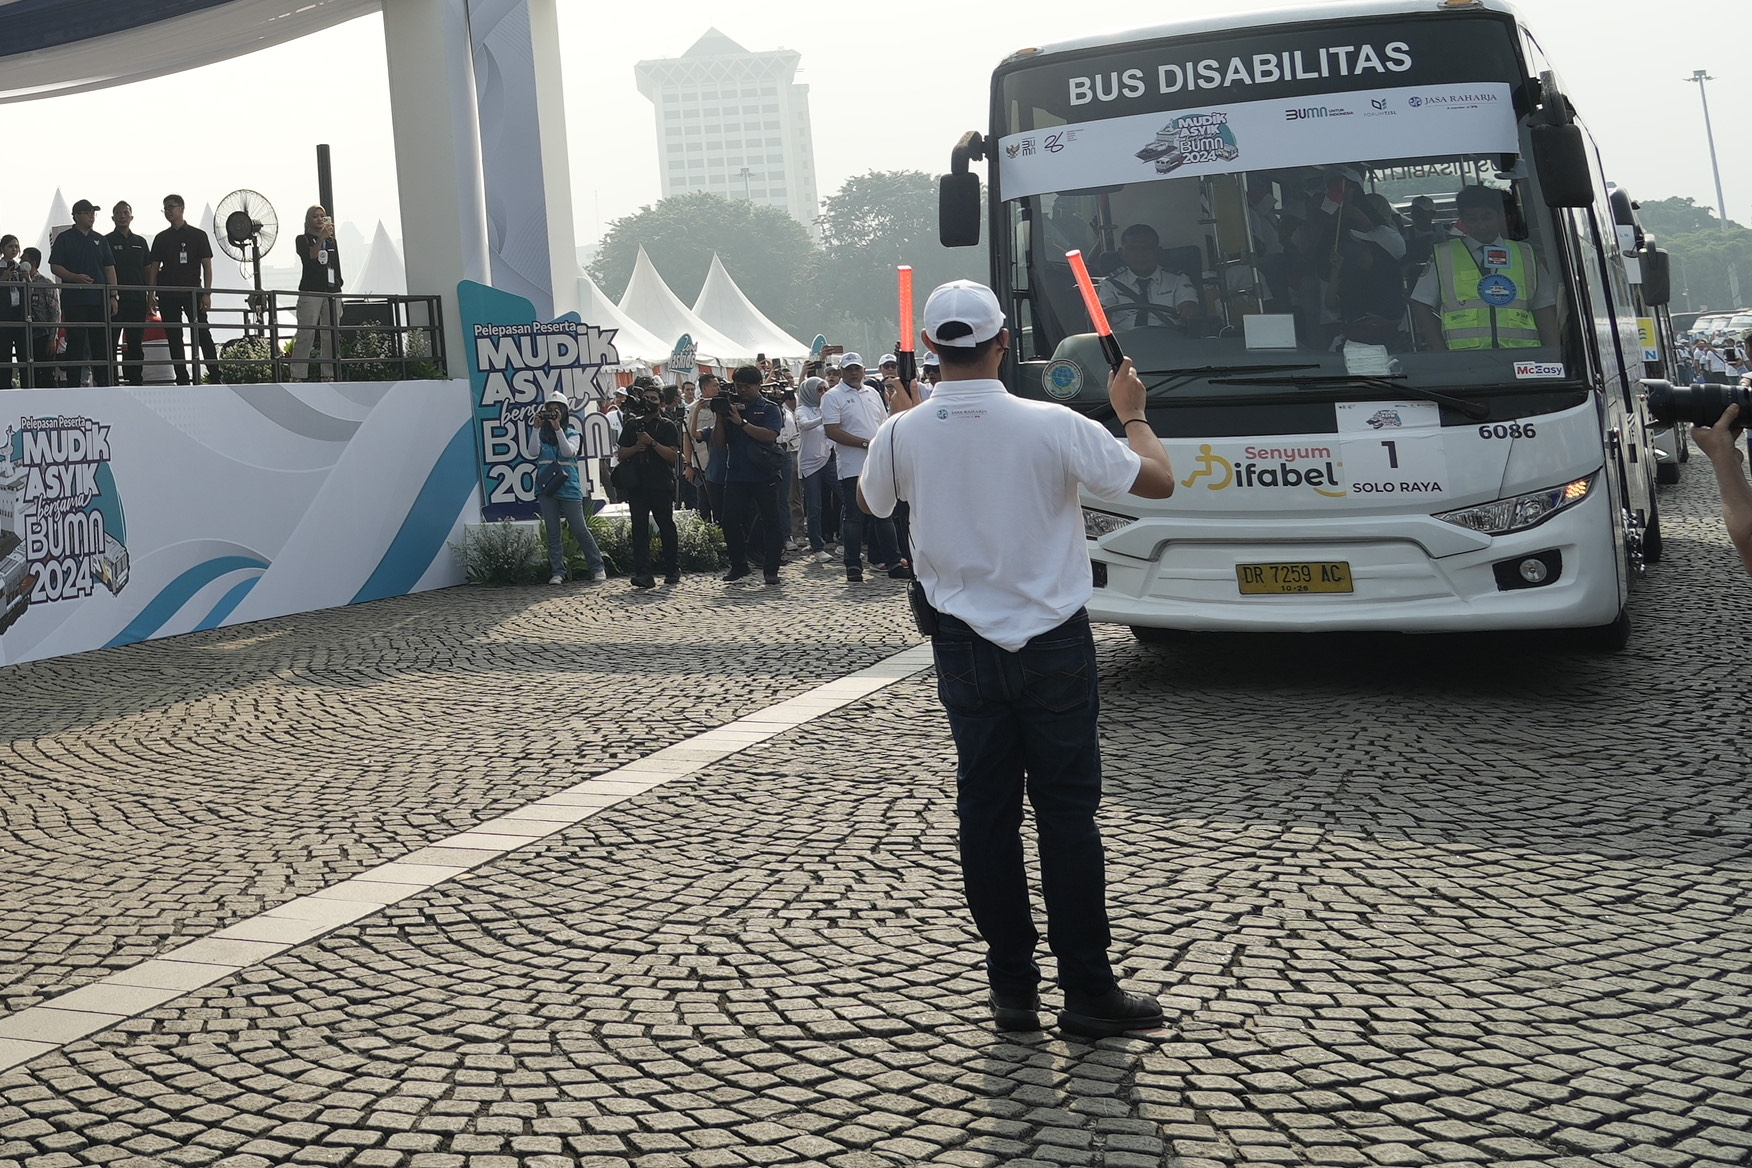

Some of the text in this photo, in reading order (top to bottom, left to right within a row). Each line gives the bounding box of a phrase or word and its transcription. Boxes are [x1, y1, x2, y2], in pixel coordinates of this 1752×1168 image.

[1068, 40, 1413, 107] BUS DISABILITAS
[1425, 93, 1497, 106] JASA RAHARJA
[1179, 124, 1221, 138] ASYIK
[1182, 151, 1218, 164] 2024
[474, 321, 578, 337] Pelepasan Peserta
[1516, 365, 1563, 376] McEasy
[480, 366, 606, 408] ASYIK
[21, 415, 86, 430] Pelepasan Peserta
[1478, 423, 1537, 440] 6086
[1244, 444, 1331, 463] Senyum
[1381, 440, 1399, 469] 1
[23, 463, 100, 503] ASYIK
[488, 459, 595, 505] 204
[1352, 481, 1443, 493] SOLO RAYA
[36, 490, 93, 520] bersama
[28, 557, 94, 605] 2024
[1242, 564, 1343, 585] DR 7259 AC
[1280, 585, 1310, 593] 10-26
